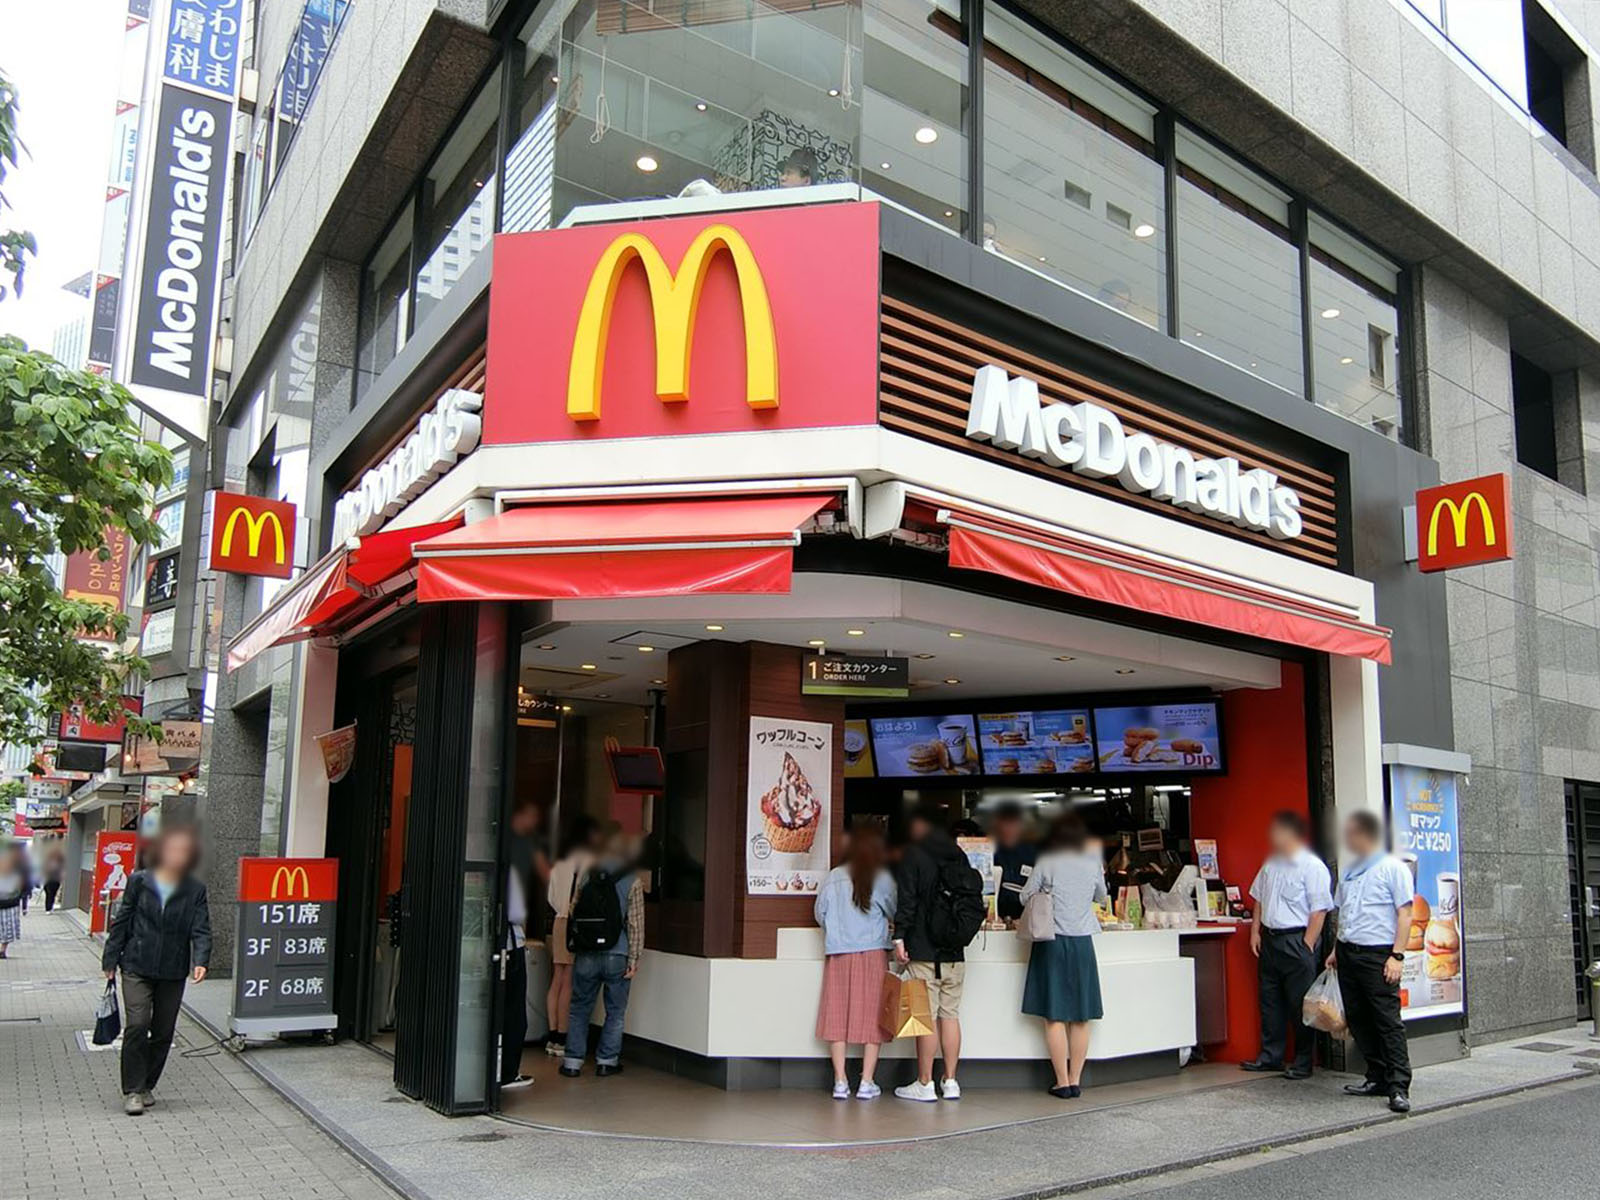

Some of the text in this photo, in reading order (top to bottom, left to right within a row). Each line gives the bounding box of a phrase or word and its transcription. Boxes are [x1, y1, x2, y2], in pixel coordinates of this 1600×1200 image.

[150, 108, 216, 379] McDonald's
[965, 363, 1303, 540] McDonald's
[823, 661, 897, 674] ご注文カウンター
[823, 673, 867, 682] ORDER HERE
[756, 728, 825, 751] ワッフルコーン
[1183, 752, 1214, 769] Dip
[259, 903, 321, 925] 151席
[247, 937, 328, 956] 3F 83席
[244, 977, 325, 998] 2F 68席
